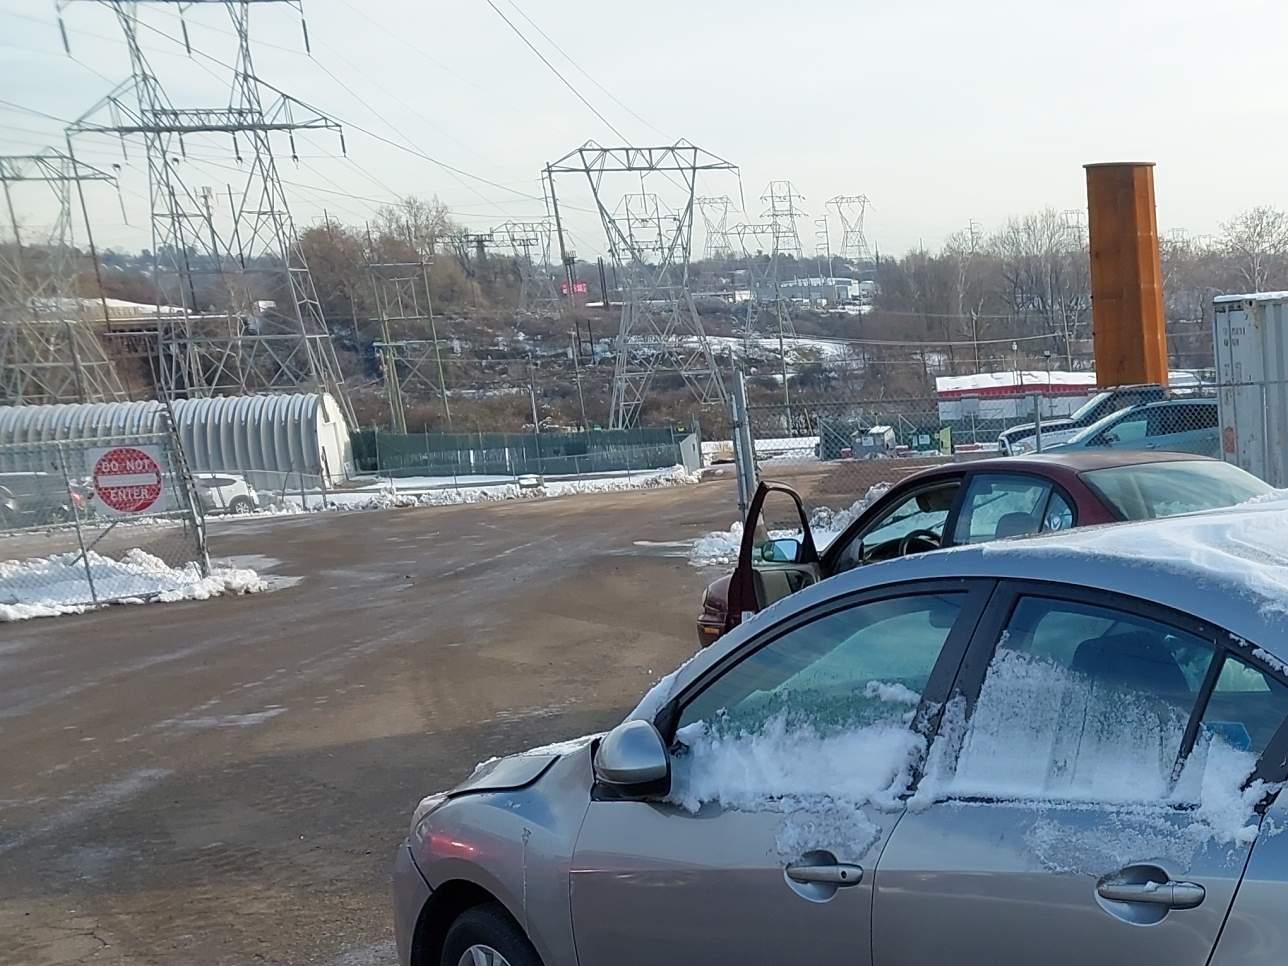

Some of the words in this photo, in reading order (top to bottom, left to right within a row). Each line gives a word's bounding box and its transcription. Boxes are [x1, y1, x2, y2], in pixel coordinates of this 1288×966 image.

[102, 461, 119, 472] DO
[126, 460, 149, 471] NOT
[110, 488, 149, 500] ENTER
